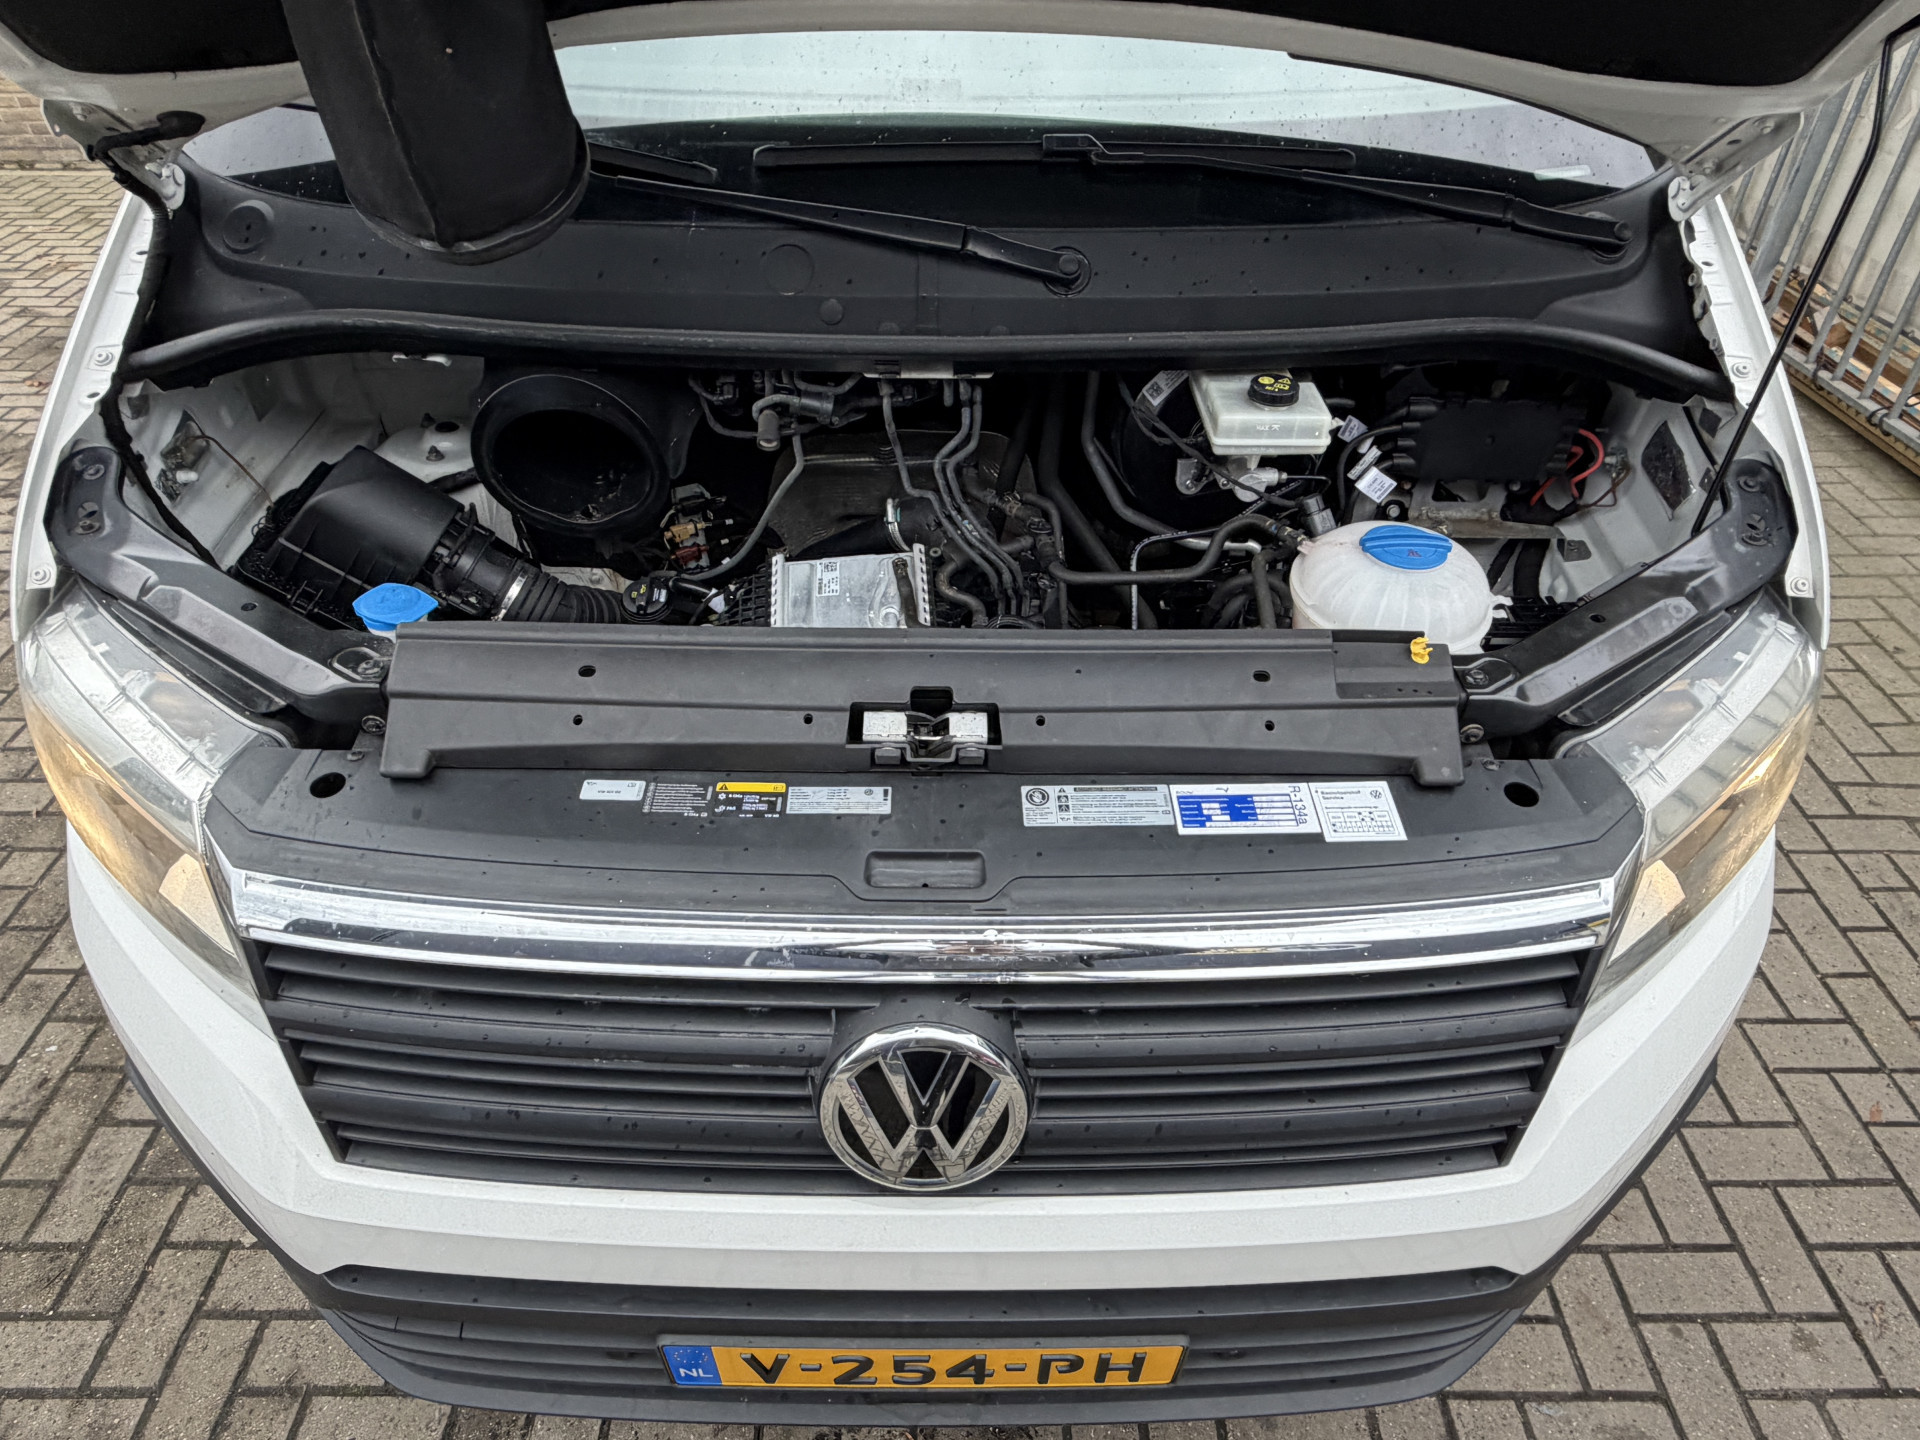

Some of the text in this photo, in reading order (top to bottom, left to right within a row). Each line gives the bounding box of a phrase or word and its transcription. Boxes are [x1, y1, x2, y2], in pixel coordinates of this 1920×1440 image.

[1288, 785, 1308, 825] R-134a
[680, 1366, 713, 1378] NL
[740, 1352, 1147, 1385] V-254-PH
